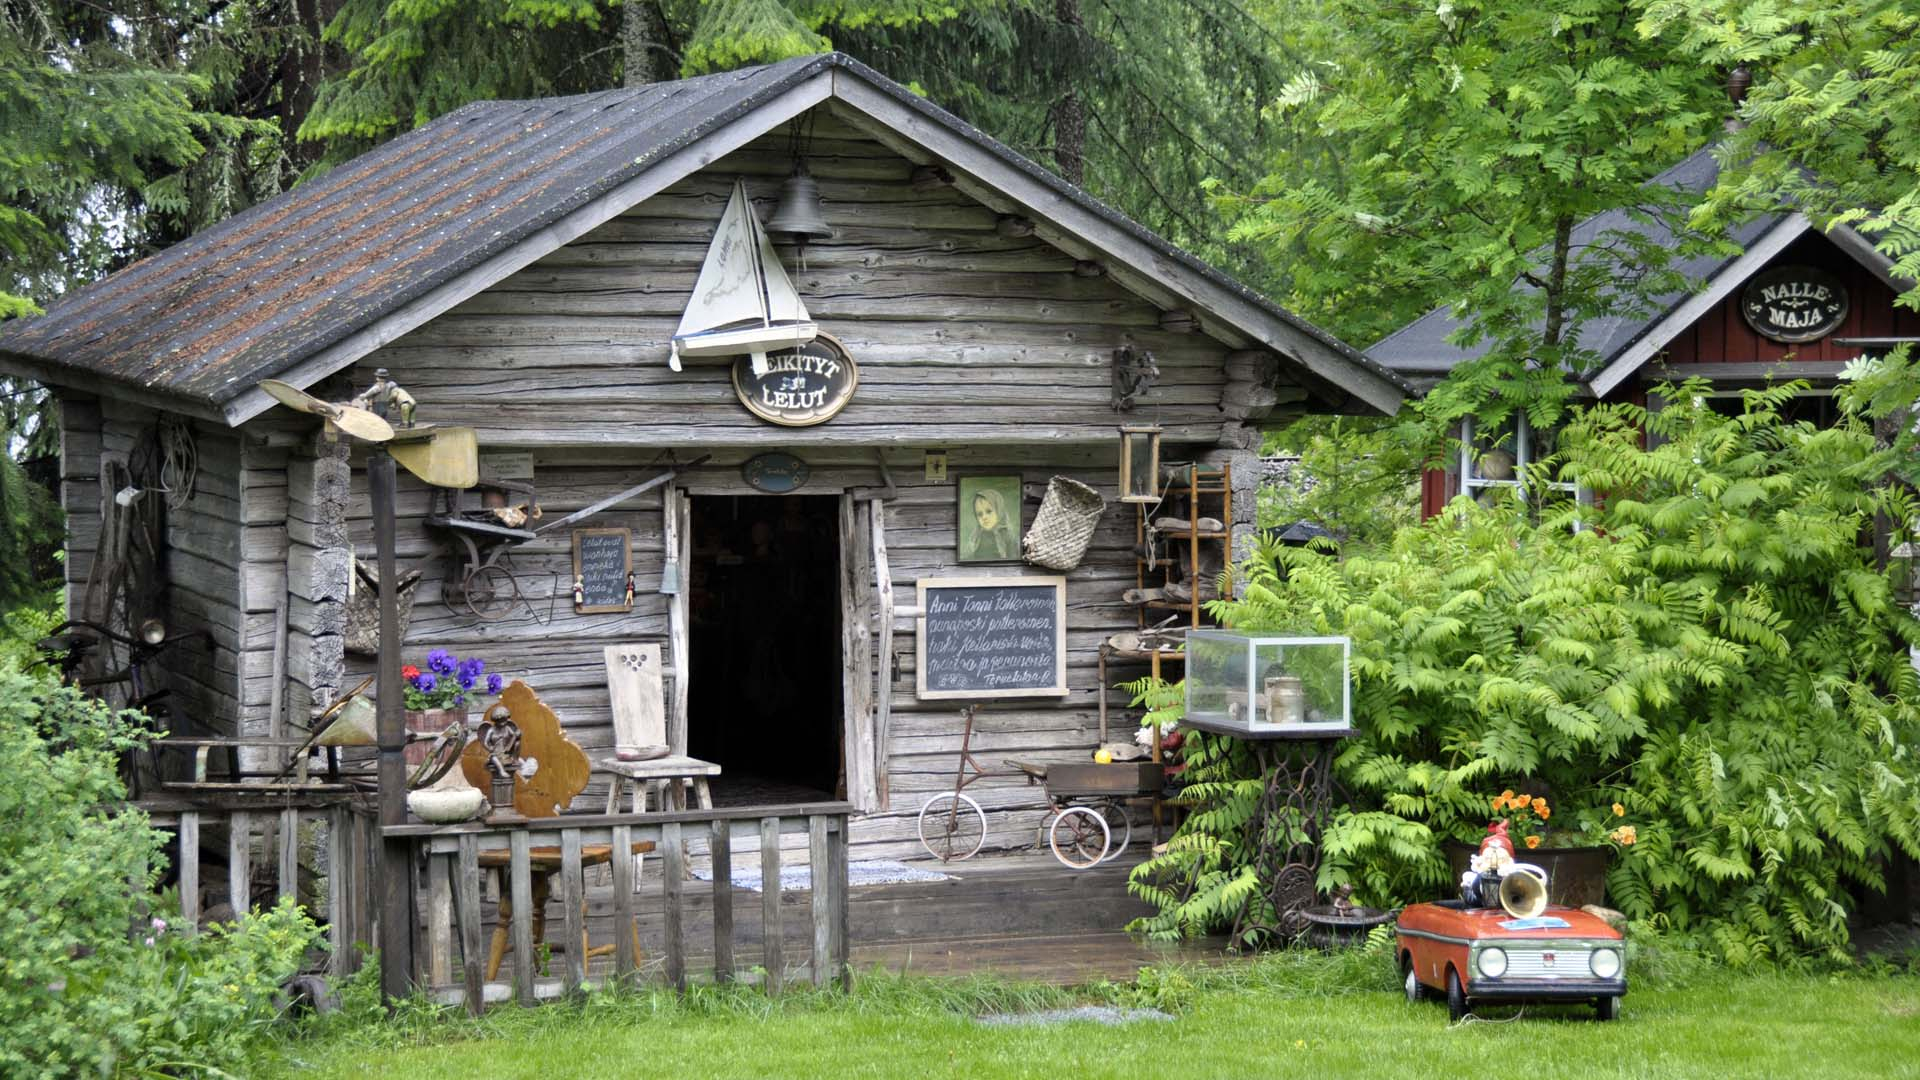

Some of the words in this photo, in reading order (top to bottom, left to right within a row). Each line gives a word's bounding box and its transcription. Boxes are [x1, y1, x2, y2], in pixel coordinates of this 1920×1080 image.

[1761, 282, 1829, 303] NALLE
[1768, 306, 1823, 328] MAJA
[752, 354, 840, 379] EIKITYT
[762, 384, 827, 408] LELUT
[930, 595, 958, 613] Anni
[962, 595, 994, 613] Tanni
